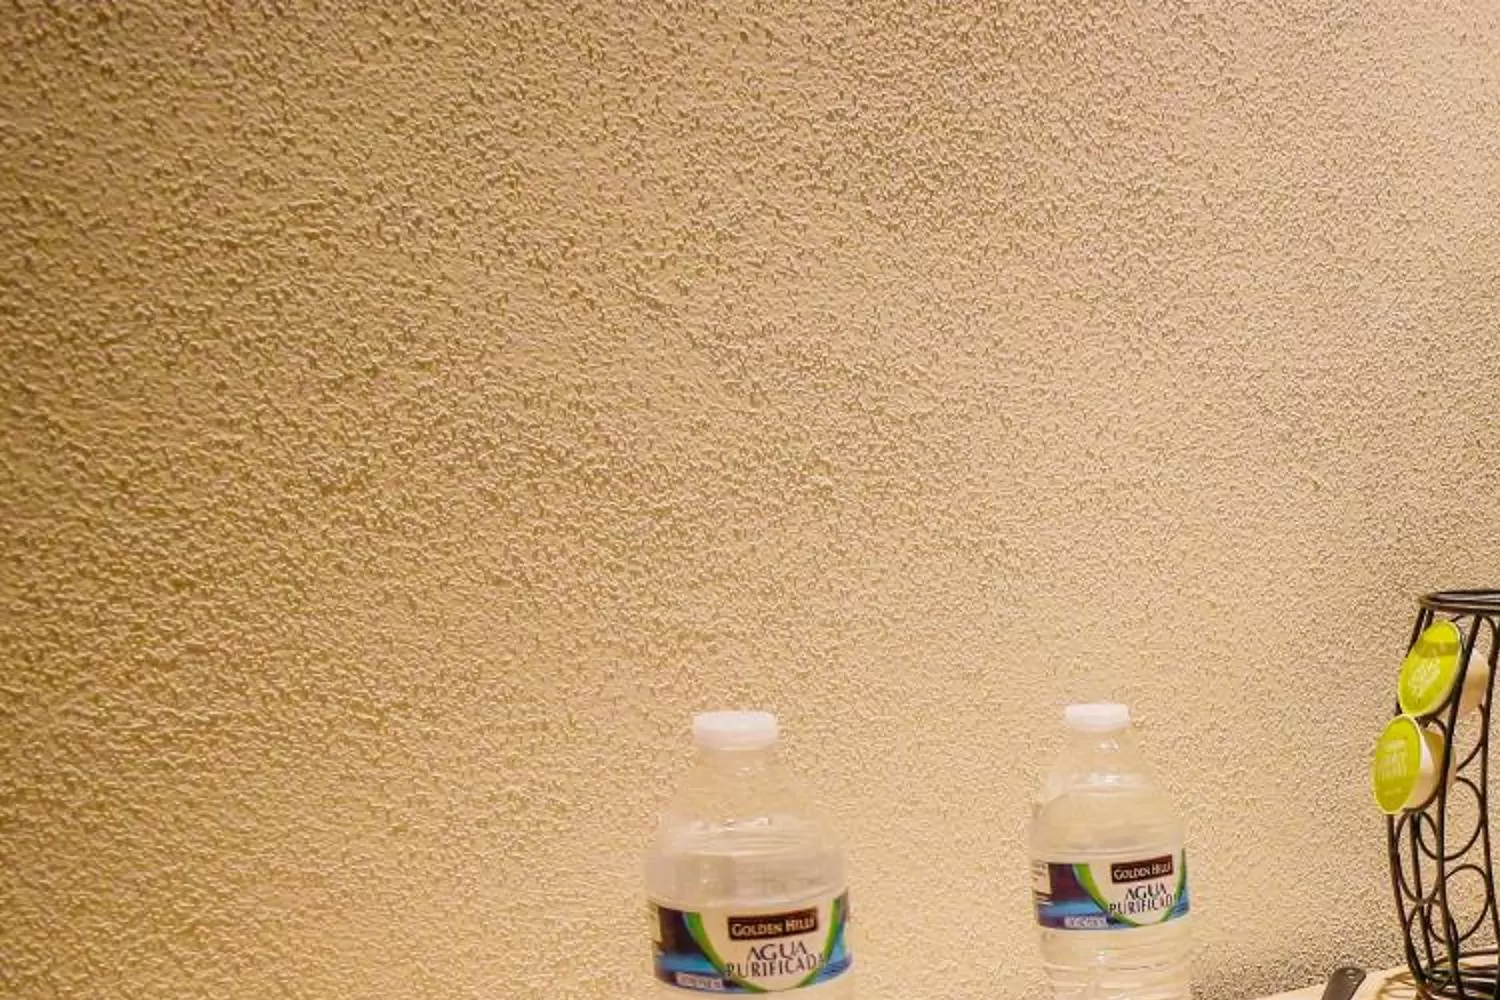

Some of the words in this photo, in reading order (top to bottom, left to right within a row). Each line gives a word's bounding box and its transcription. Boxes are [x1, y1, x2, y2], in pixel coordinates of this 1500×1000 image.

[1125, 883, 1167, 900] AGUA
[732, 922, 783, 937] GOLDEN
[746, 940, 807, 961] AGUA
